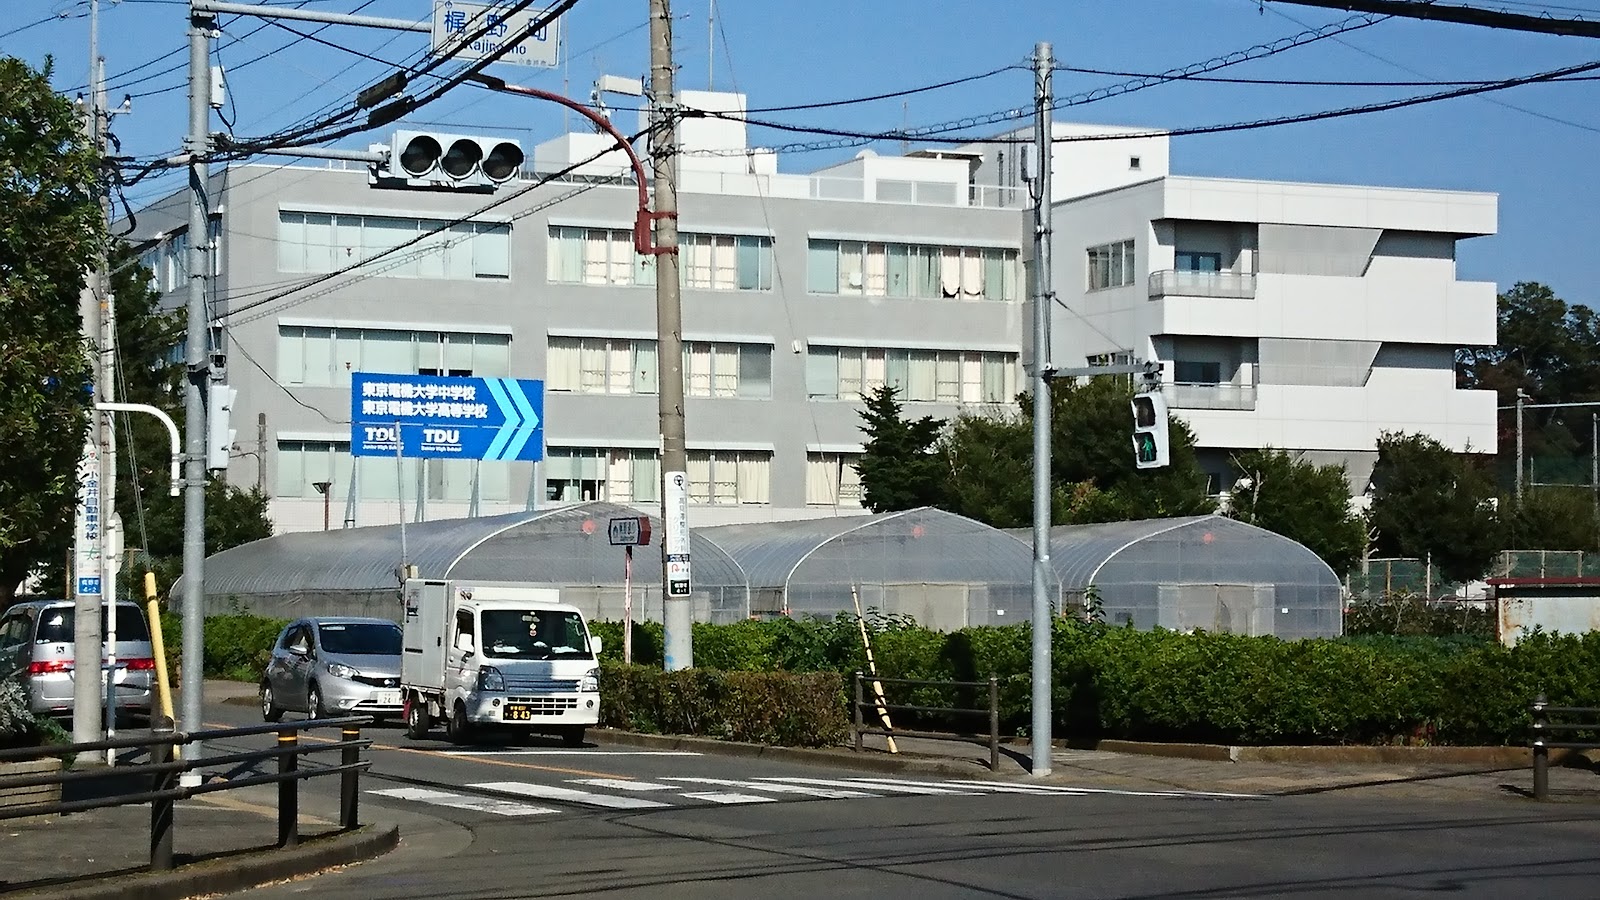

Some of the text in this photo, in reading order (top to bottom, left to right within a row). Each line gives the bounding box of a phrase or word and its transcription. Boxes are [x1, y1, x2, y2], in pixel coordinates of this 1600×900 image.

[362, 381, 476, 401] 東京電機大学中学校
[362, 399, 488, 419] 東京電機大学高等学校
[423, 428, 460, 444] TDU
[85, 470, 99, 541] 小金井自動車学校
